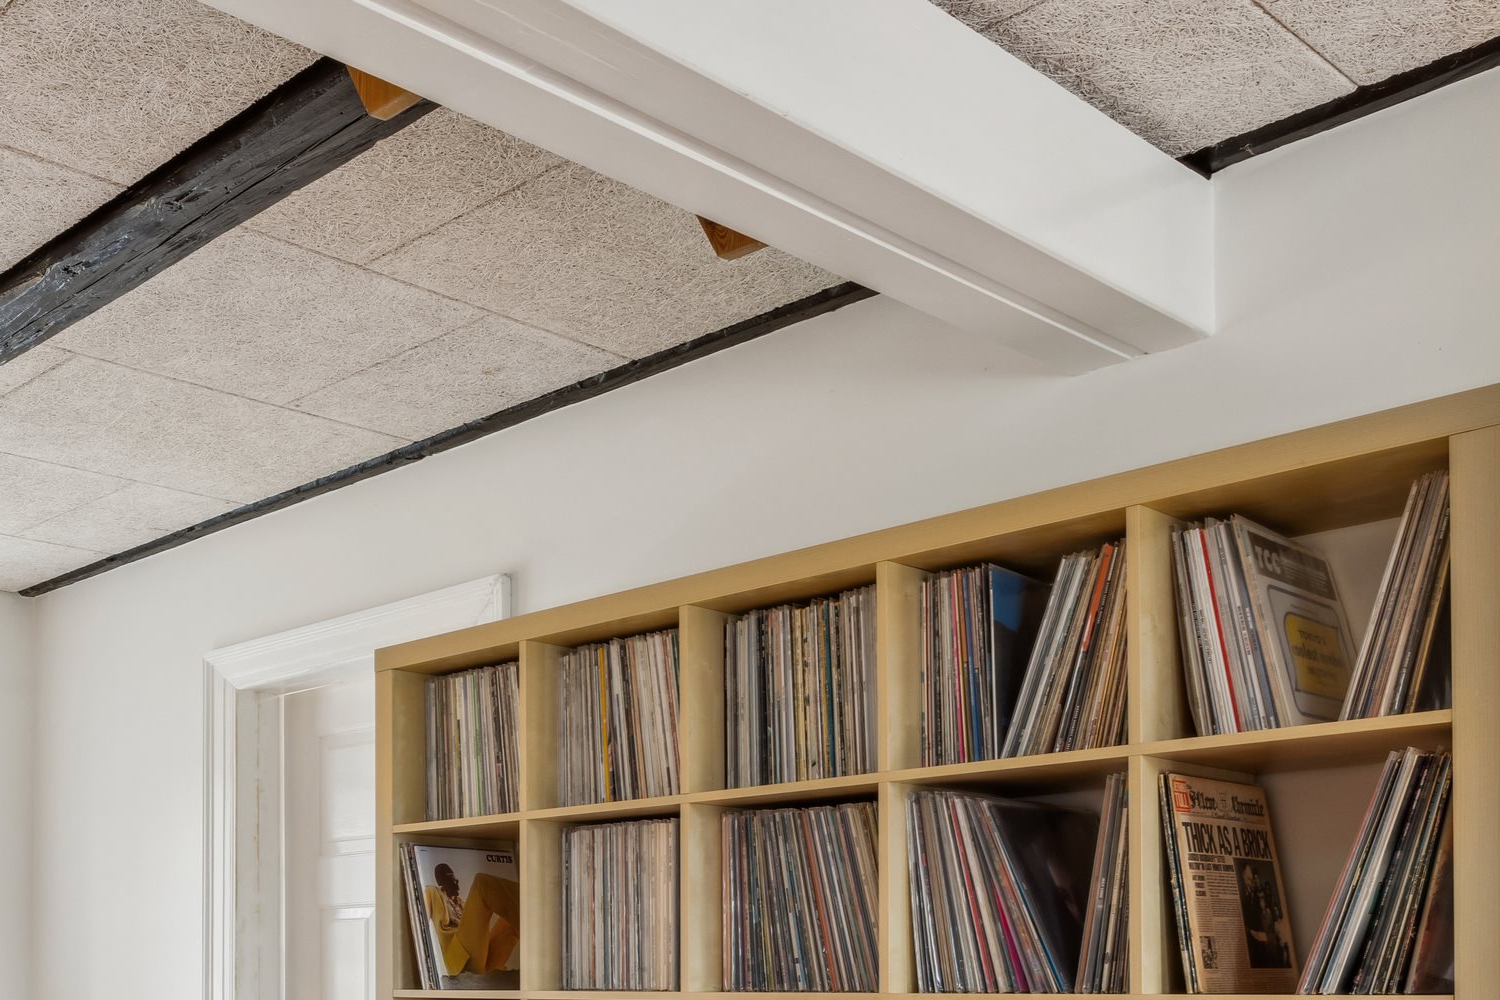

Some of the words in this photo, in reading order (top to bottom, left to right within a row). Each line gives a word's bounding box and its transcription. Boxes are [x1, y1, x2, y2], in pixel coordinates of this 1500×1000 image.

[1254, 545, 1282, 575] TCC
[1182, 822, 1218, 855] THICK
[1217, 825, 1234, 857] AS
[1231, 827, 1243, 857] A
[1240, 829, 1273, 860] BRICK
[486, 854, 513, 864] CURTIS
